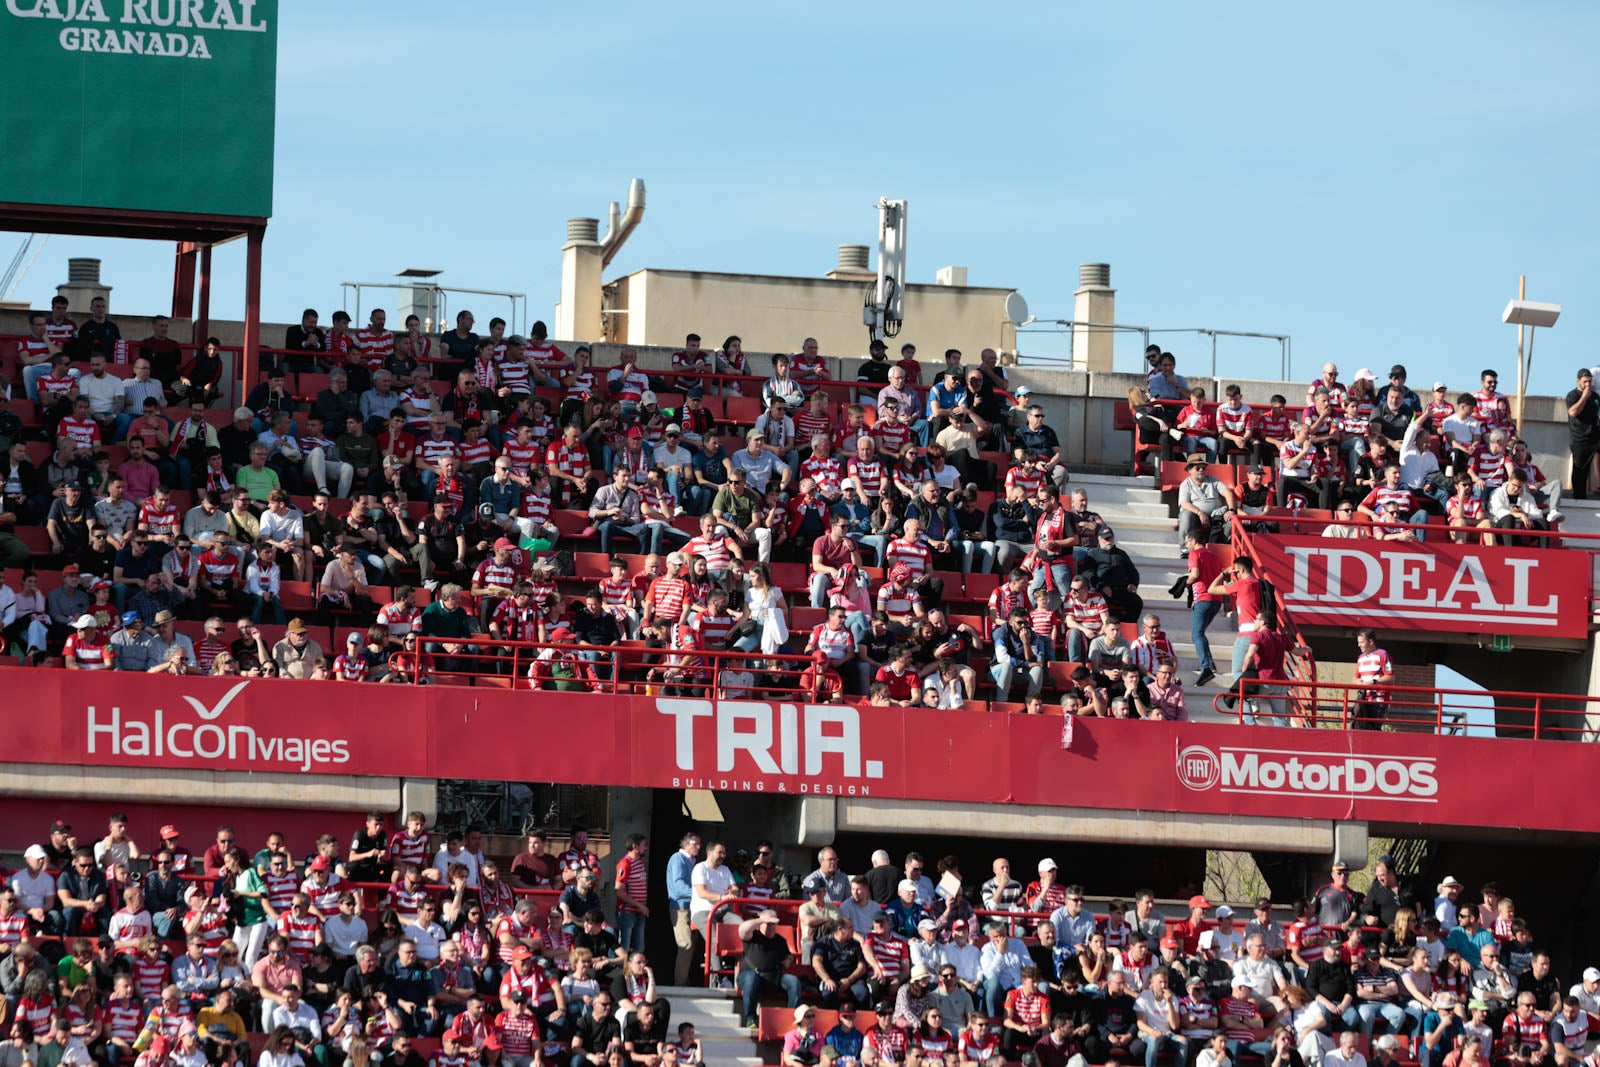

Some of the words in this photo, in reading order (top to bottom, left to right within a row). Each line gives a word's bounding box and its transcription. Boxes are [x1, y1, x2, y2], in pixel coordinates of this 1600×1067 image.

[6, 0, 110, 22] CAJA
[120, 0, 267, 32] RURAL
[59, 27, 212, 59] GRANADA
[1283, 546, 1559, 614] IDEAL
[655, 697, 884, 779] TRIA.
[1186, 758, 1210, 779] FIAT
[1220, 752, 1439, 797] MotorDOS
[672, 777, 765, 791] BUILDING
[777, 782, 787, 792] &
[800, 783, 870, 796] DESIGN
